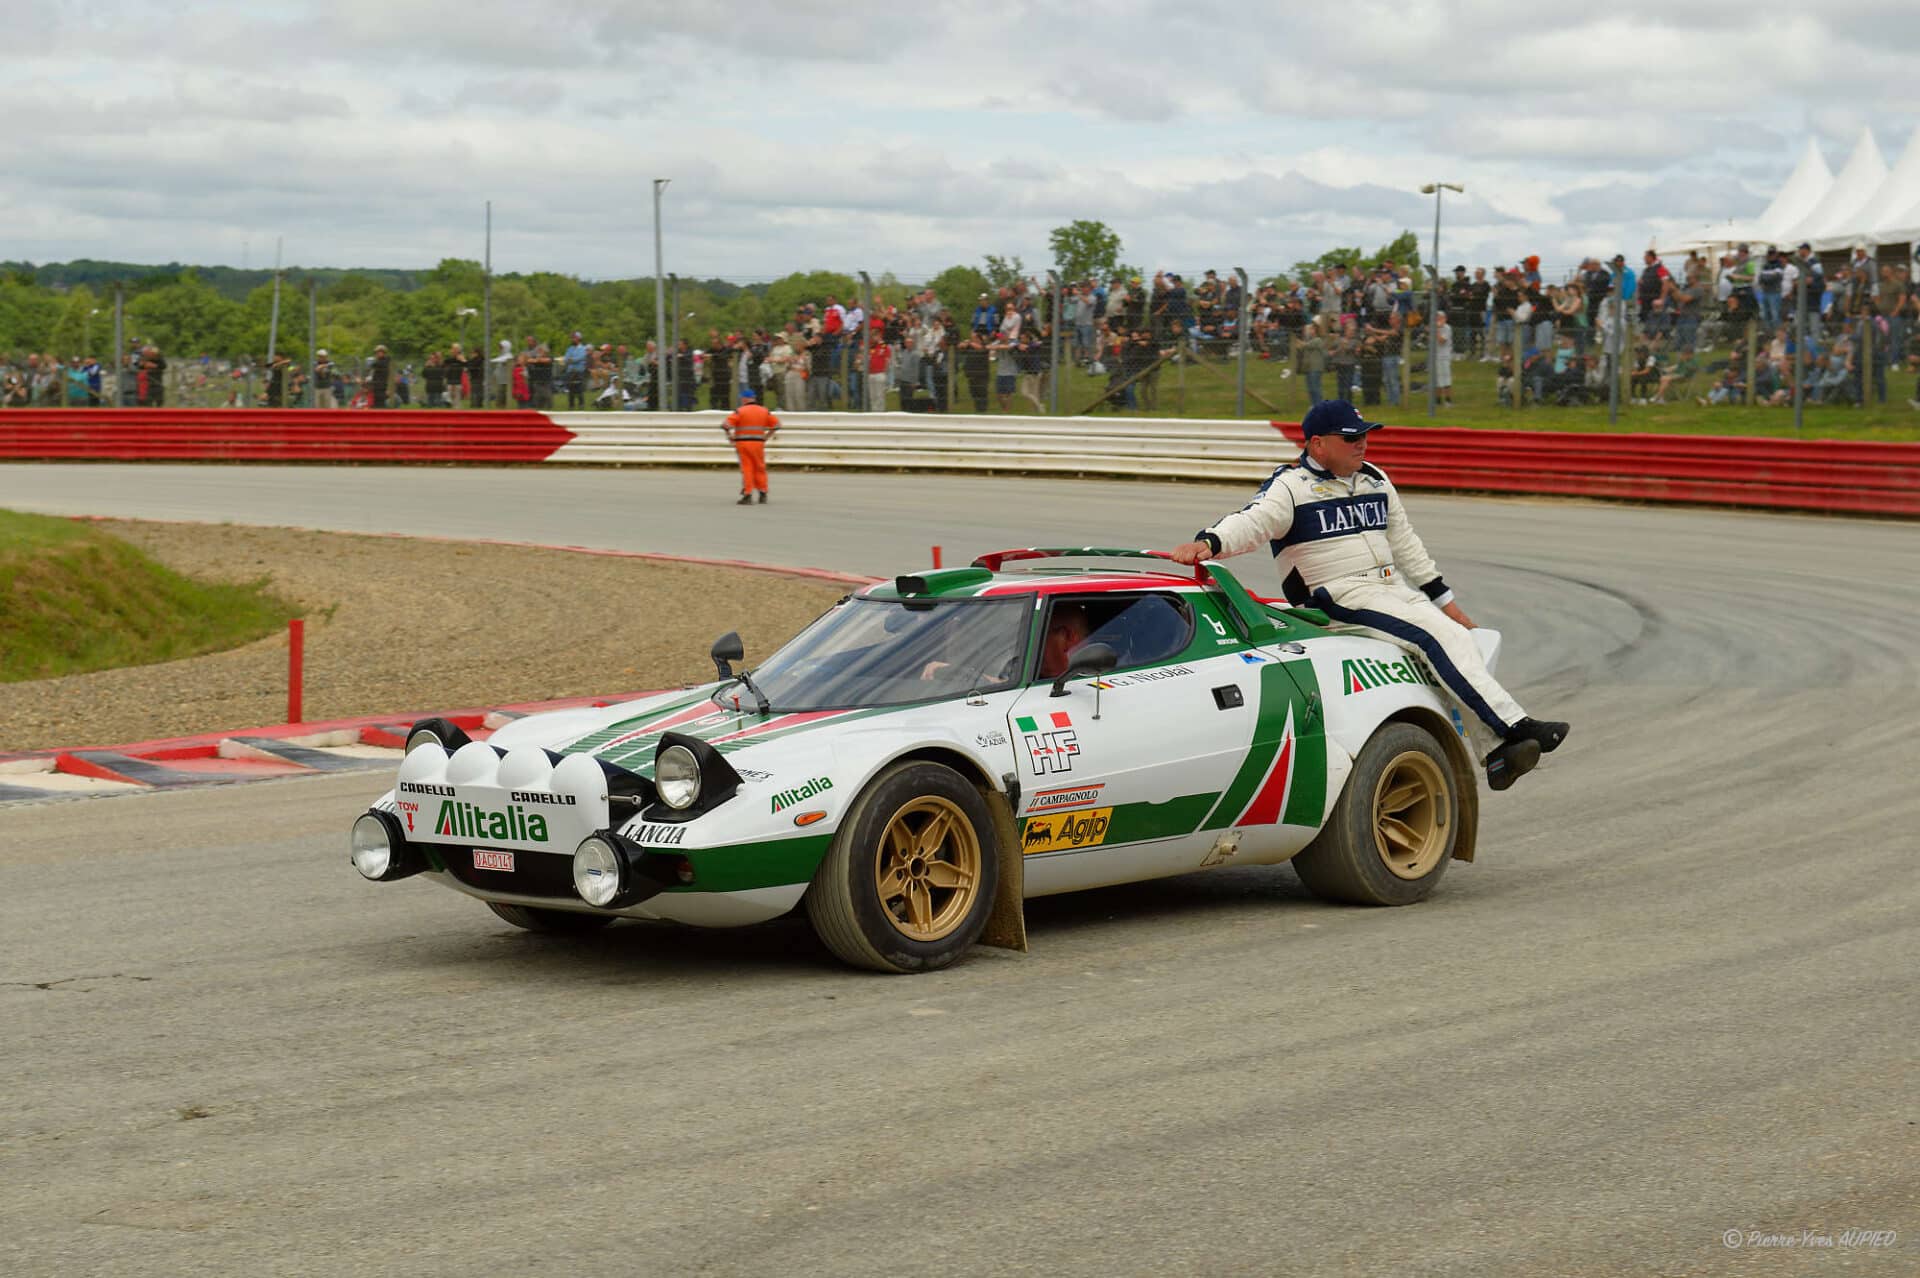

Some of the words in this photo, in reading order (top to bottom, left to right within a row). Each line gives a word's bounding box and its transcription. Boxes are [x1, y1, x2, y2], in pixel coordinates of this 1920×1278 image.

[1316, 501, 1388, 534] LANCIA
[1342, 655, 1441, 695] Alitalia
[1025, 730, 1081, 775] HF
[400, 782, 456, 797] CARELLO
[511, 791, 576, 806] CARELLO
[771, 775, 834, 815] Alitalia
[1040, 789, 1099, 806] CAMPAGNOLO
[397, 801, 419, 812] TOW
[434, 799, 549, 842] Alitalia
[622, 824, 688, 844] LANCIA
[1056, 811, 1108, 846] Agip
